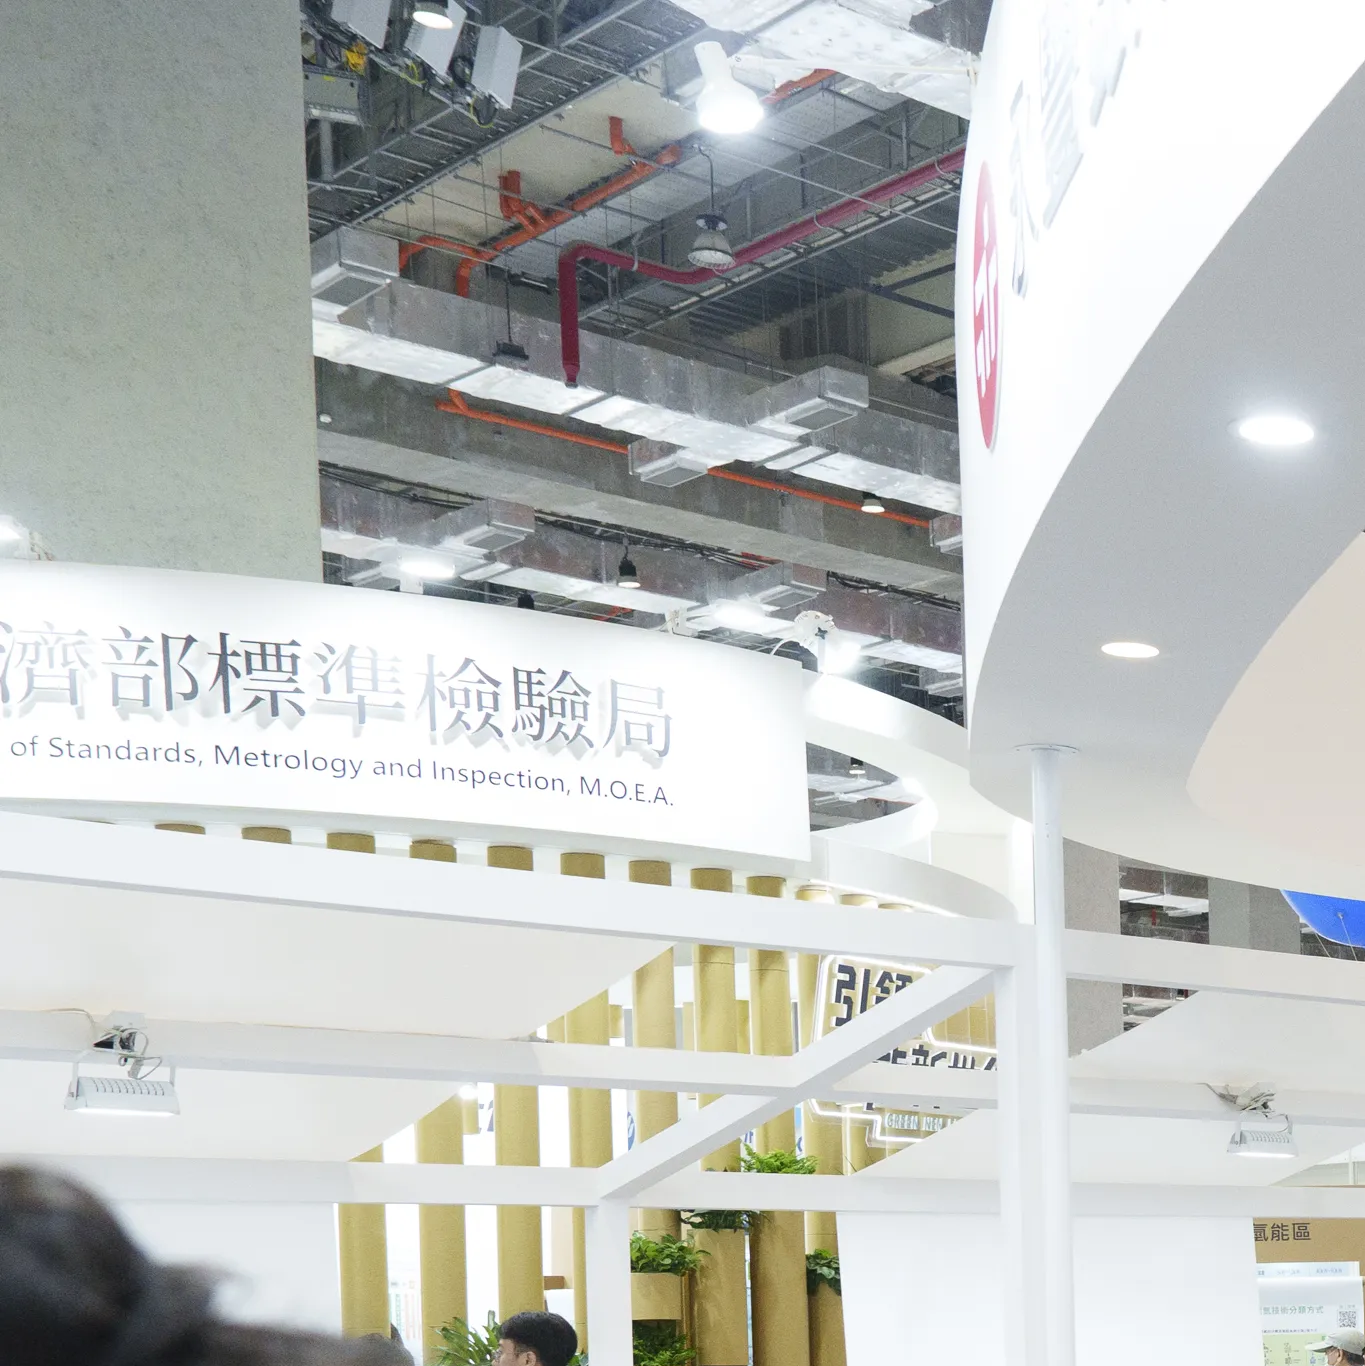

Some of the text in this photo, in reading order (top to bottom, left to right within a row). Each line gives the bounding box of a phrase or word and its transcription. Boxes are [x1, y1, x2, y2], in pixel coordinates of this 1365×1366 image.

[10, 735, 674, 806] of Standards, Metrology and Inspection, M.O.E.A.
